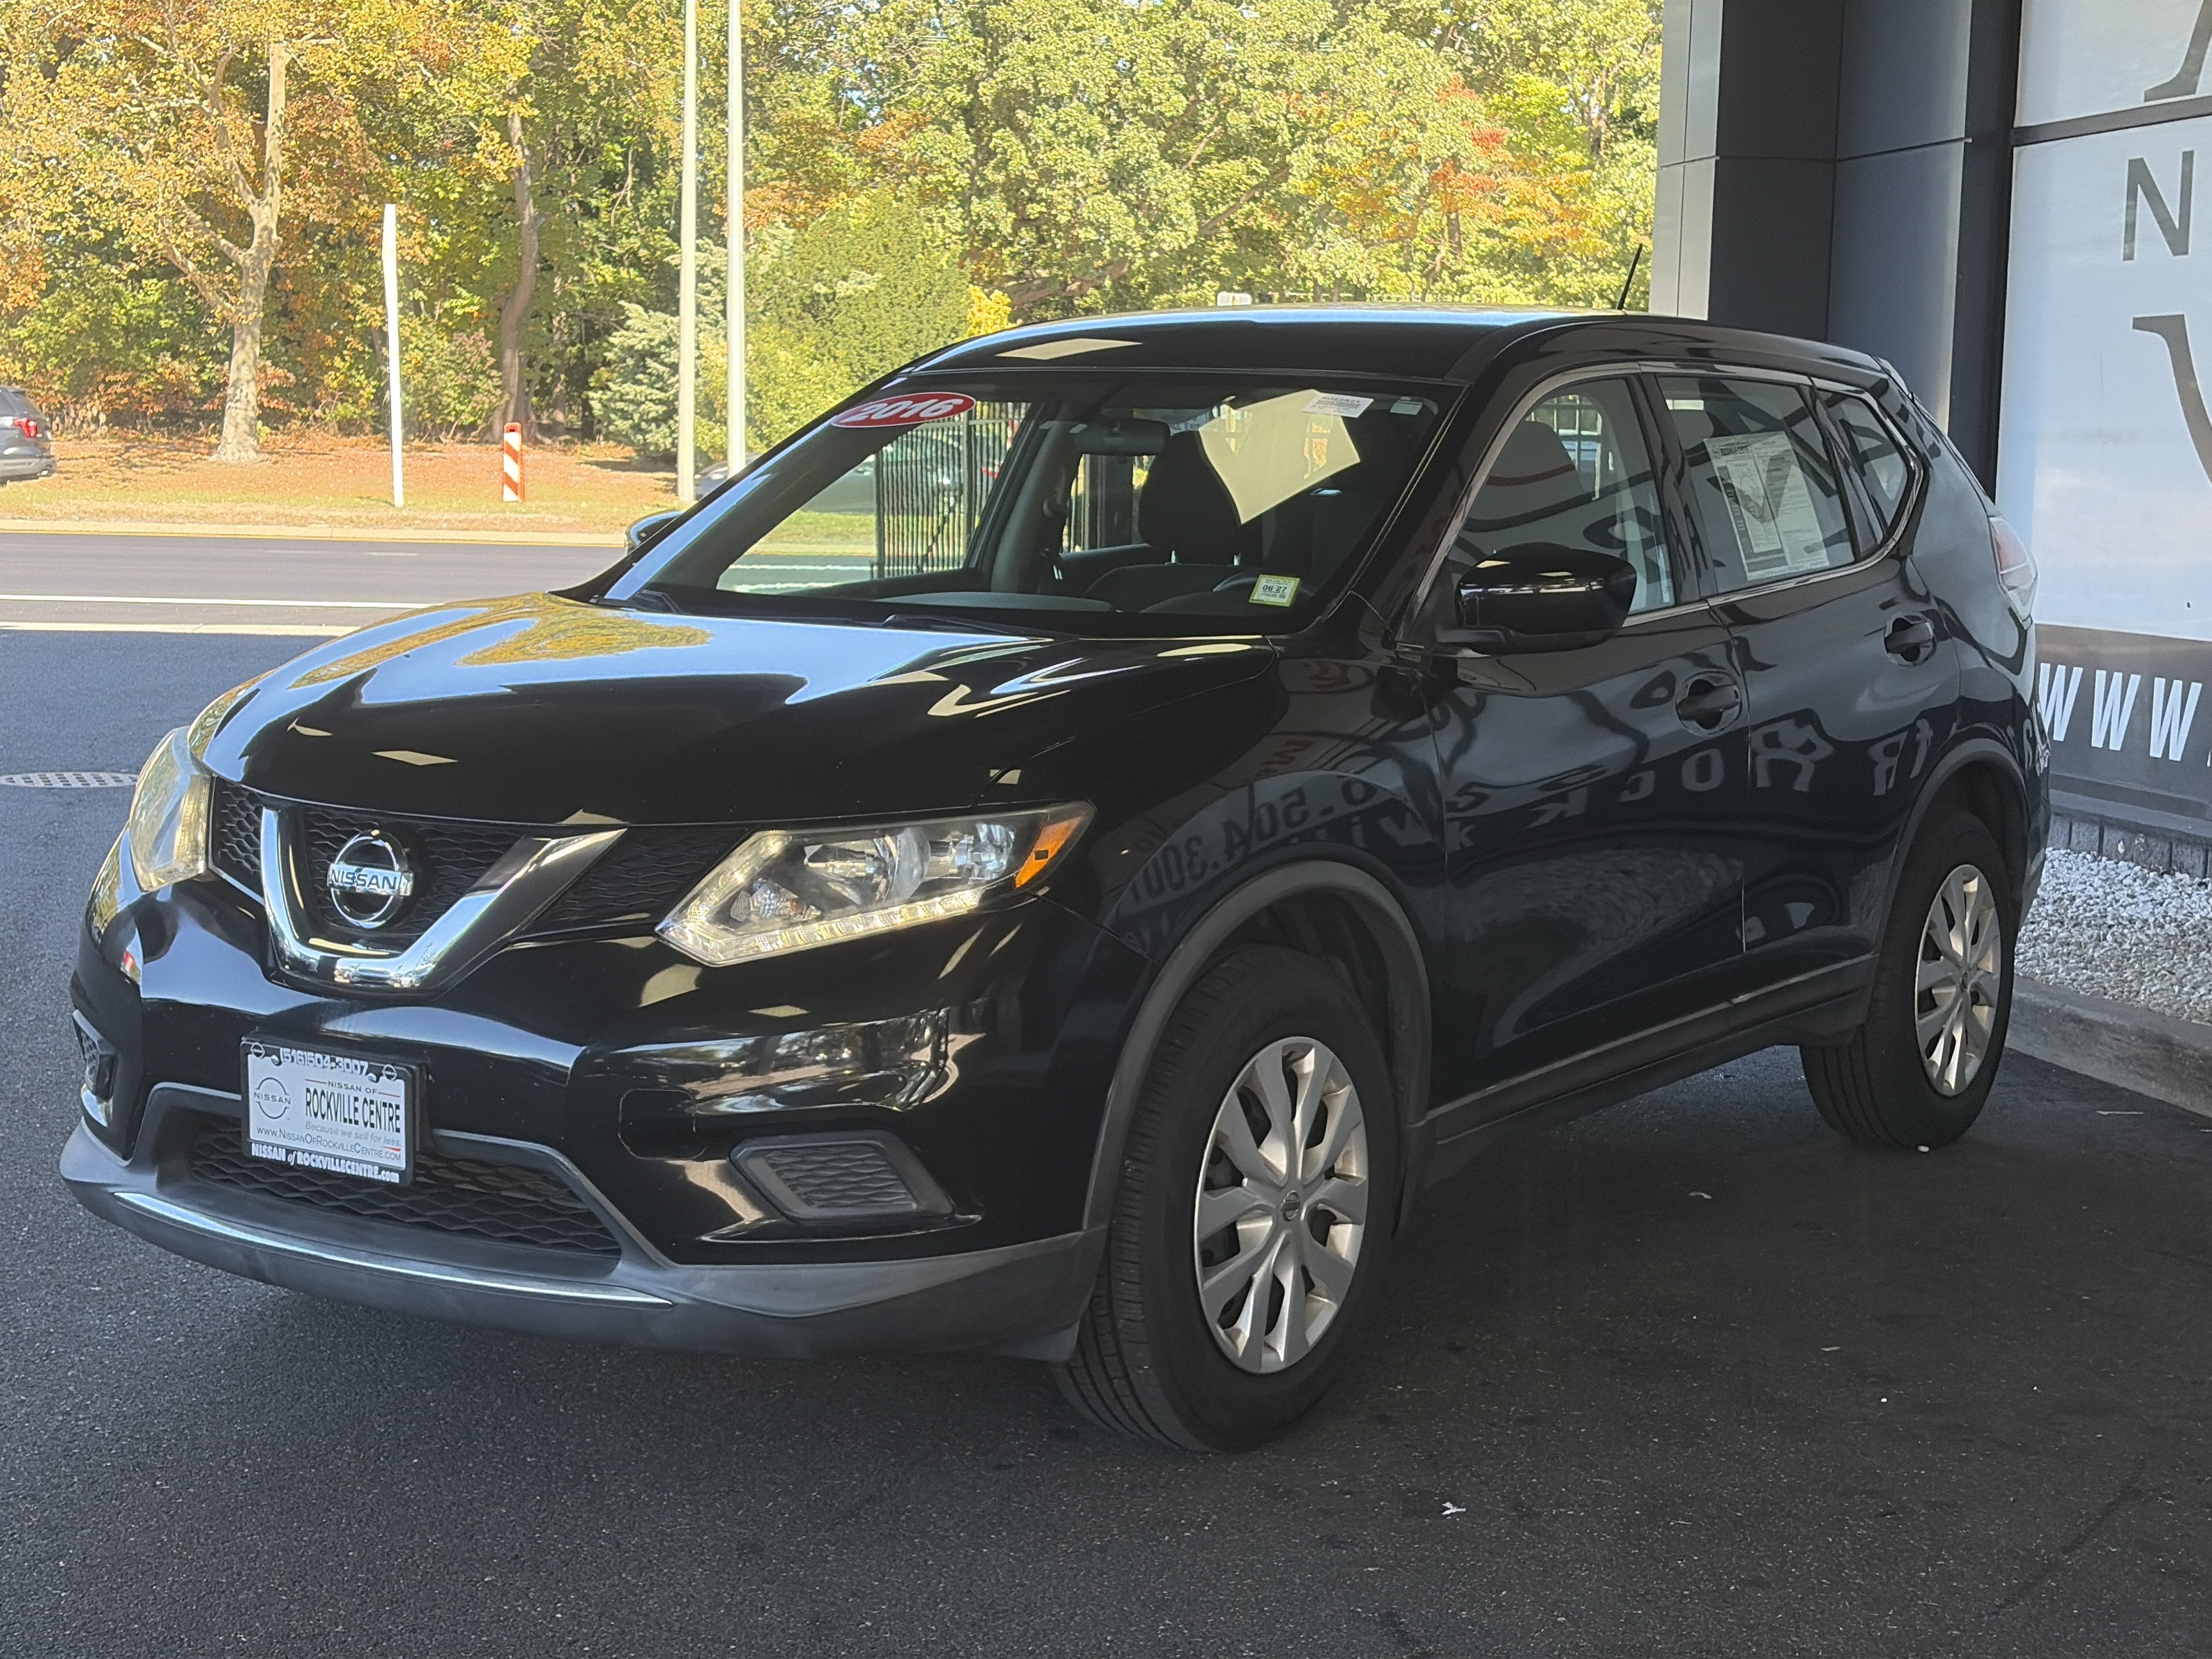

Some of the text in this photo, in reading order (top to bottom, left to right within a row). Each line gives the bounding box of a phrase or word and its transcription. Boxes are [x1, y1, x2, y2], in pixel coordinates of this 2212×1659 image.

[840, 398, 964, 424] 2016
[329, 869, 398, 890] NISSAN
[328, 1081, 362, 1092] NISSAN
[253, 1092, 291, 1105] NISSAN
[305, 1087, 401, 1134] ROCKVILLE CENTRE
[305, 1121, 339, 1136] Because
[341, 1130, 352, 1138] we
[354, 1131, 369, 1141] sell
[370, 1133, 382, 1142] for
[251, 1142, 400, 1184] NISSAN of ROCKVILLECENTRE.com
